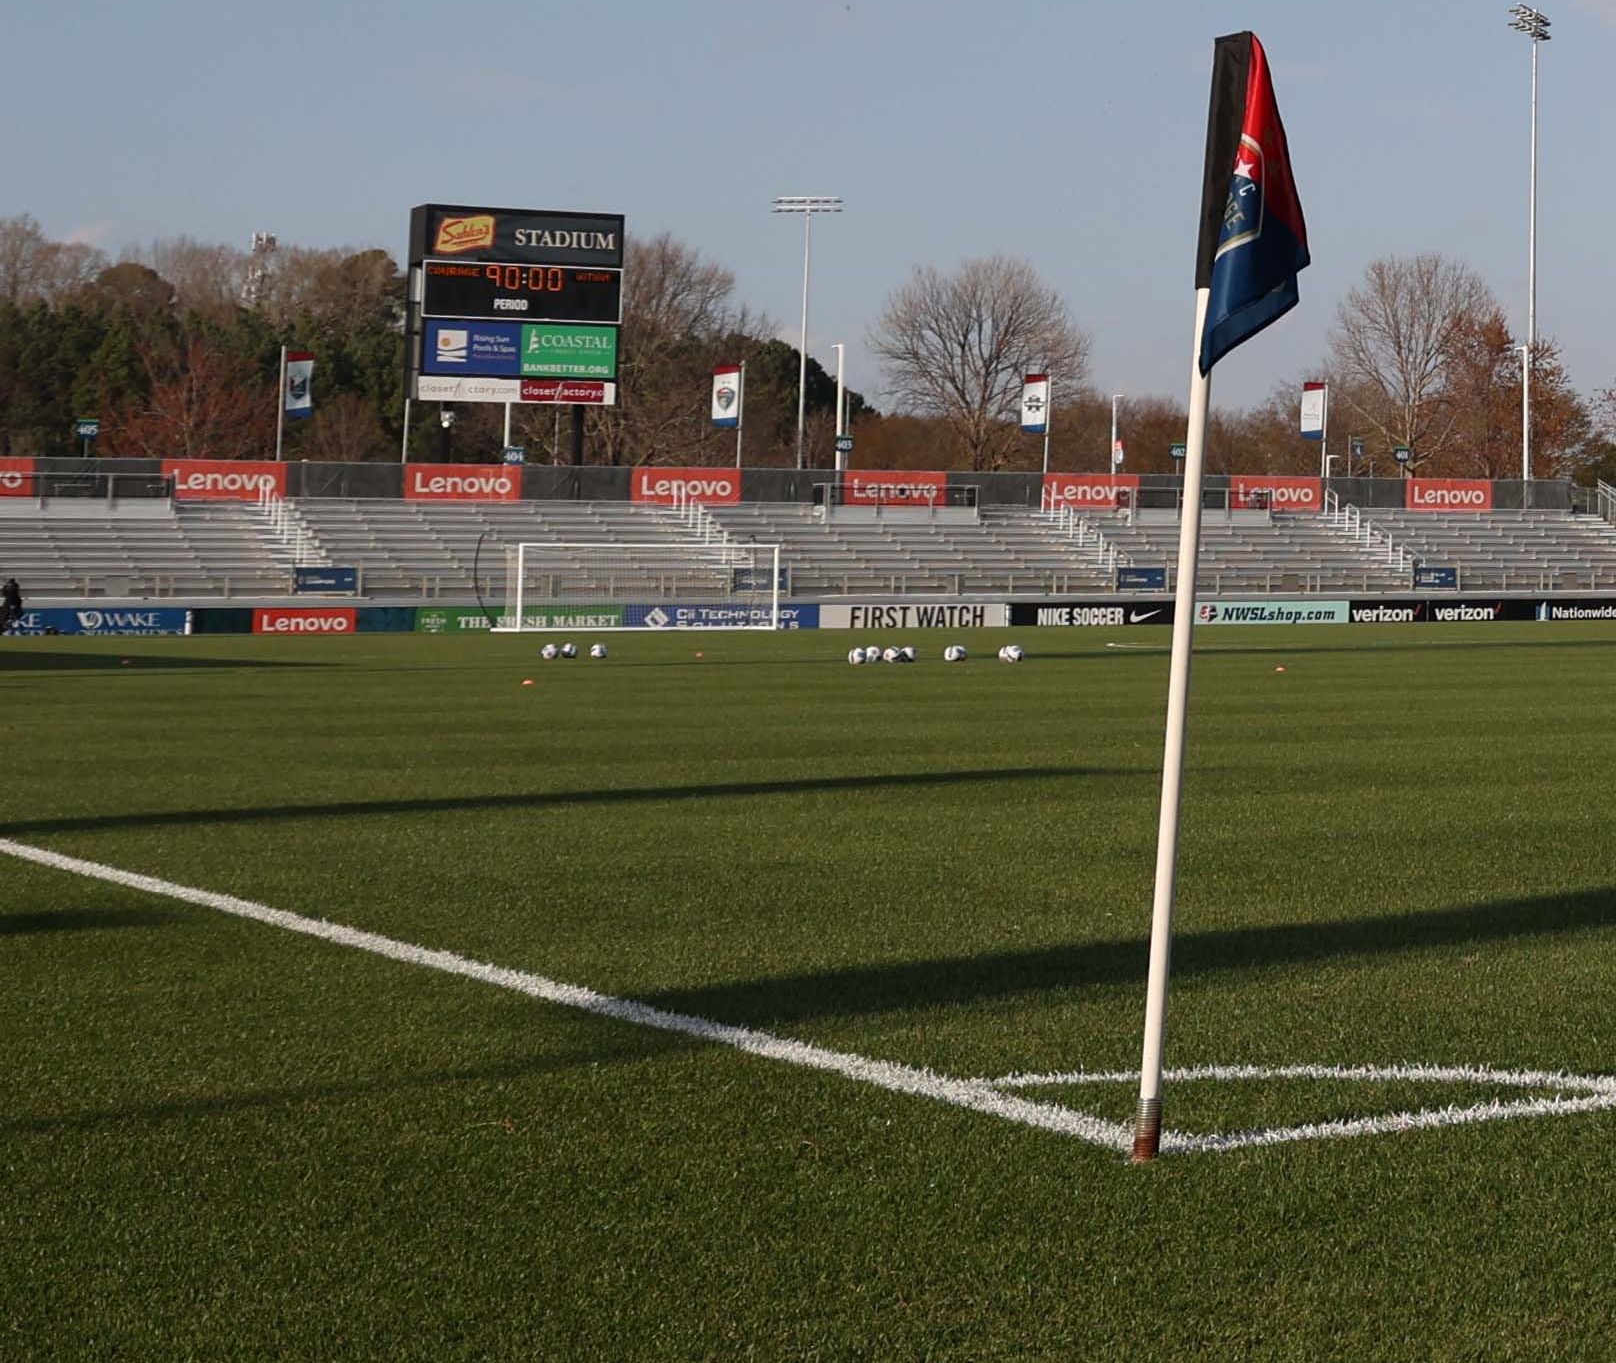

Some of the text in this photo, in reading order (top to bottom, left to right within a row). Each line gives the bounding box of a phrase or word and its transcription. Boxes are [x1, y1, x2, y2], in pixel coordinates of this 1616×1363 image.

[515, 228, 615, 250] STADIUM
[485, 265, 564, 292] 90:00
[493, 298, 528, 310] PERIOD
[542, 334, 613, 349] COASTAL
[523, 363, 609, 374] BANKBETTER.ORG
[77, 424, 98, 435] 405
[504, 450, 525, 461] 404
[175, 469, 276, 491] Lenovo
[414, 471, 512, 495] Lenovo
[641, 475, 733, 498] Lenovo
[853, 478, 938, 499] Lenovo
[1052, 480, 1132, 502] Lenovo
[1238, 483, 1314, 503] Lenovo
[1414, 485, 1485, 504] Lenovo
[104, 612, 161, 627] WAKE
[851, 605, 985, 629] FIRST WATCH
[1037, 607, 1124, 626] NIKE SOCCER
[1221, 606, 1336, 623] NWSLshop.com
[1352, 604, 1414, 622] verizon
[1434, 603, 1495, 621] verizon
[262, 614, 348, 632] Lenovo
[457, 616, 492, 628] THE
[552, 615, 619, 627] MARKET
